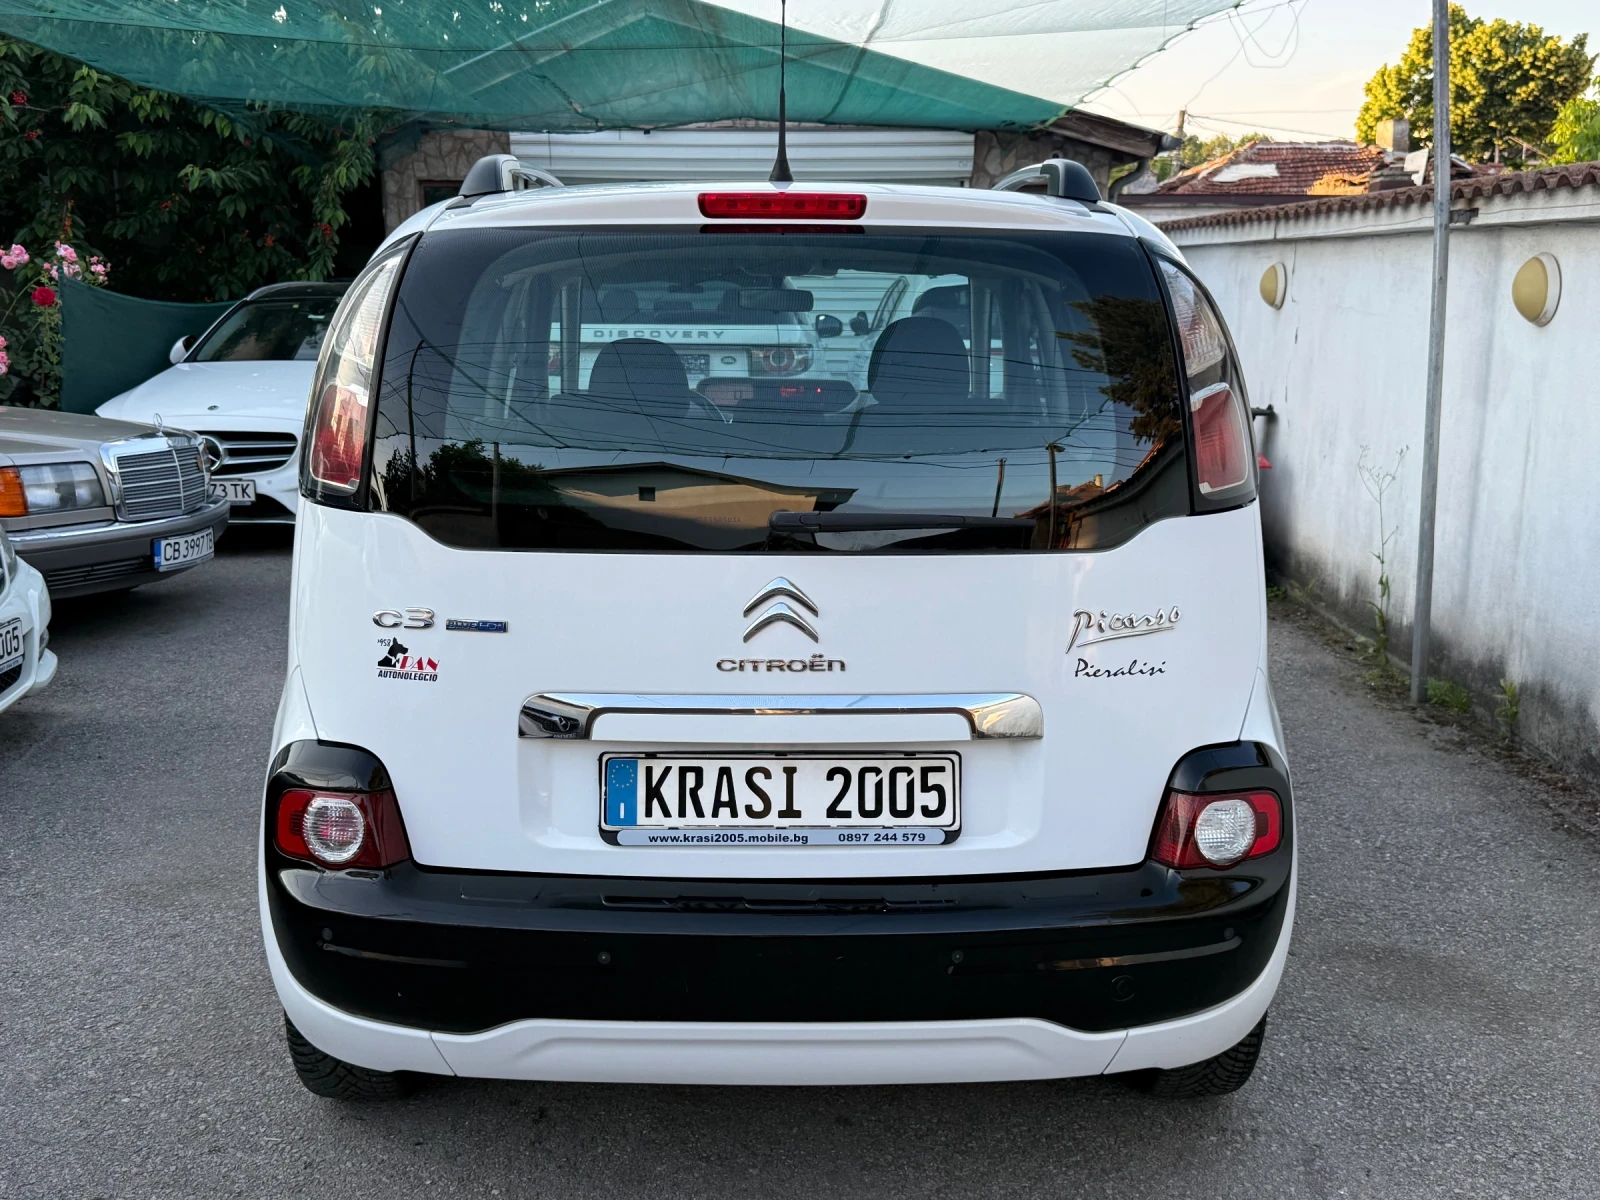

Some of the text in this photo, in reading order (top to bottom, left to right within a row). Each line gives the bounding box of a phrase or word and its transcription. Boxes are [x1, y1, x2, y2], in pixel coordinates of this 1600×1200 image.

[593, 329, 725, 339] DISCOVERY
[230, 483, 251, 499] TK
[163, 541, 181, 562] CB
[182, 535, 205, 558] 3997
[372, 607, 435, 629] C3
[1065, 605, 1181, 654] Picasso
[716, 653, 847, 673] CITROËN
[1074, 658, 1166, 678] Pieralisi
[644, 765, 946, 819] KRASI 2005
[619, 802, 625, 819] I
[648, 833, 926, 844] www.krasi2005.mobile.bg 0897 244 579
